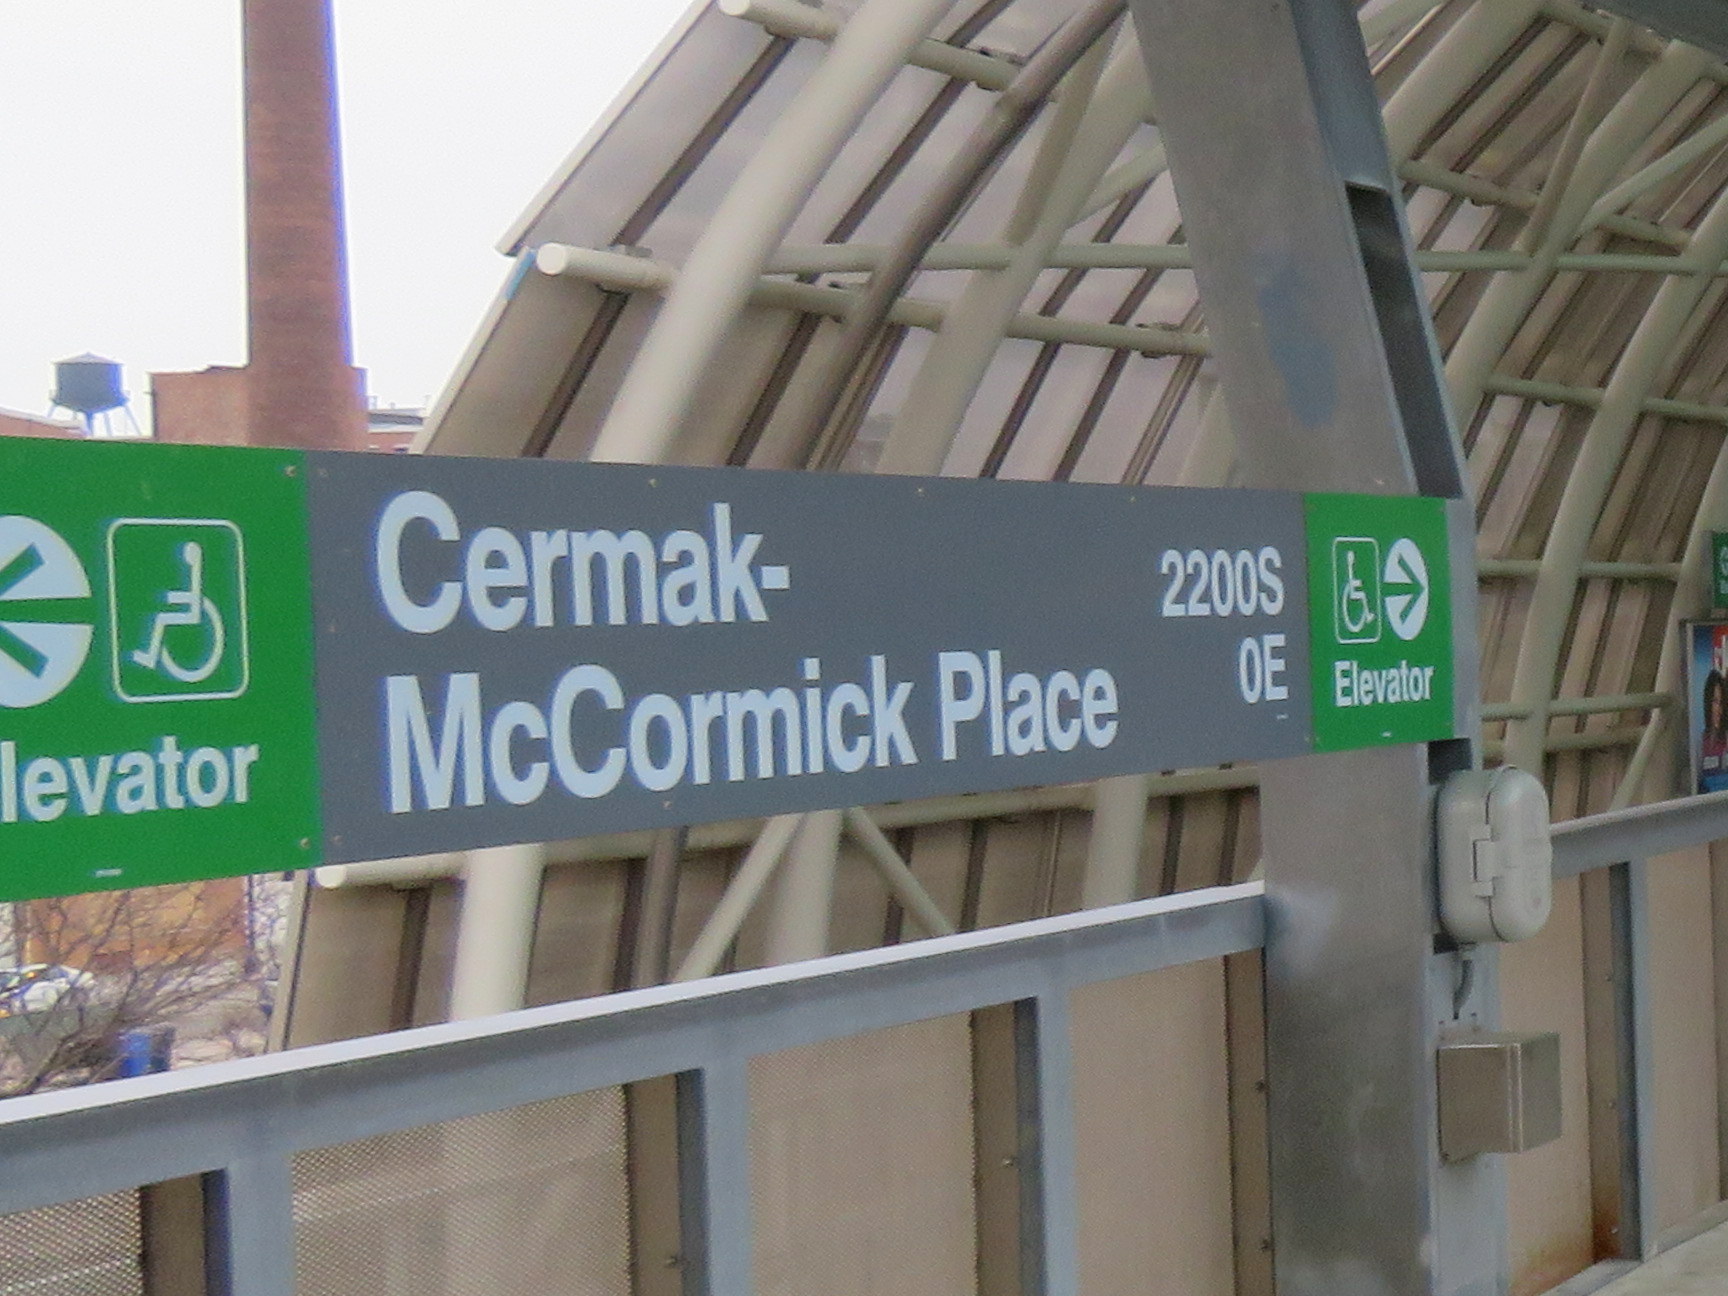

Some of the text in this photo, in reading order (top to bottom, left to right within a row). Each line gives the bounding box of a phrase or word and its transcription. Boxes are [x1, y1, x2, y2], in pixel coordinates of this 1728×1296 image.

[376, 491, 790, 634] Cermak-
[1160, 546, 1285, 618] 2200S
[1238, 634, 1288, 703] 0E
[1334, 659, 1435, 707] Elevator
[385, 649, 1119, 814] McCormick Place
[0, 736, 260, 823] levator
